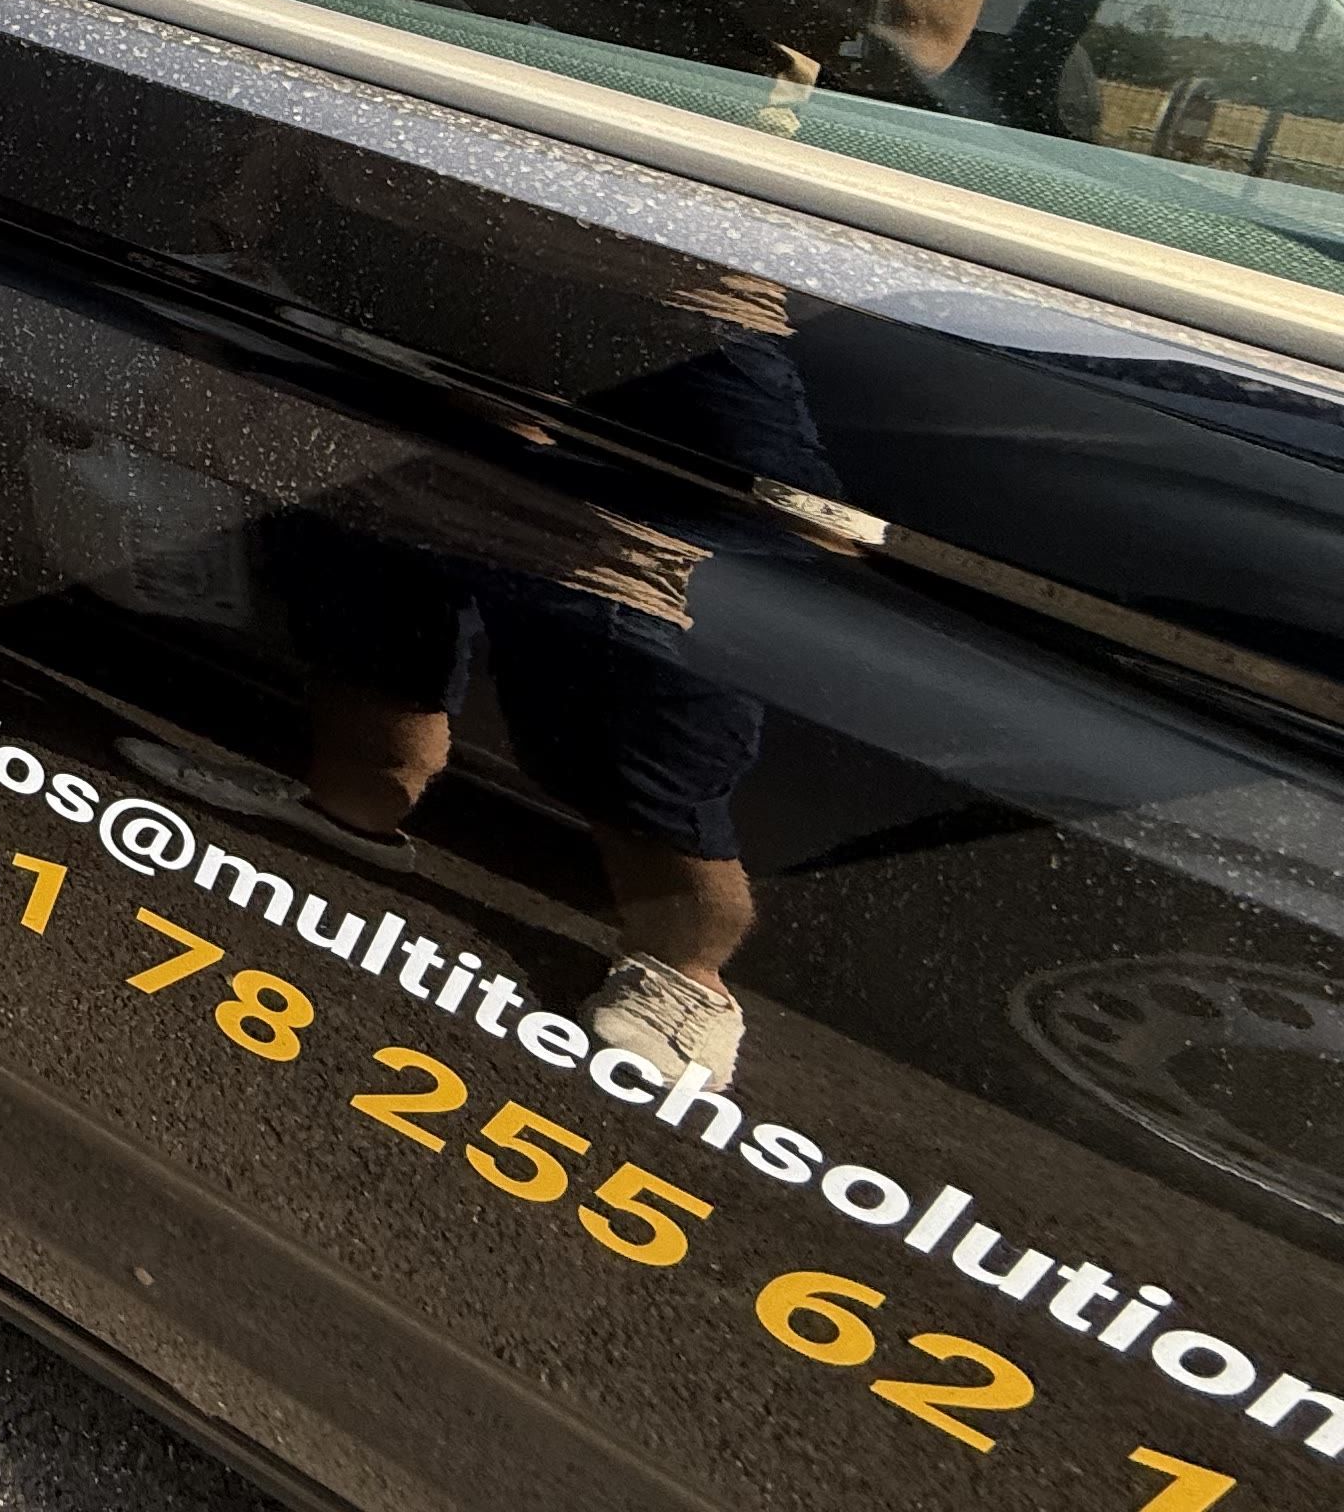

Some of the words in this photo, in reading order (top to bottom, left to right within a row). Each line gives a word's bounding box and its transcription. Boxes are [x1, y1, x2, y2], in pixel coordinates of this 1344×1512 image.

[126, 907, 315, 1062] 78
[350, 1047, 715, 1266] 255
[754, 1271, 1036, 1452] 62
